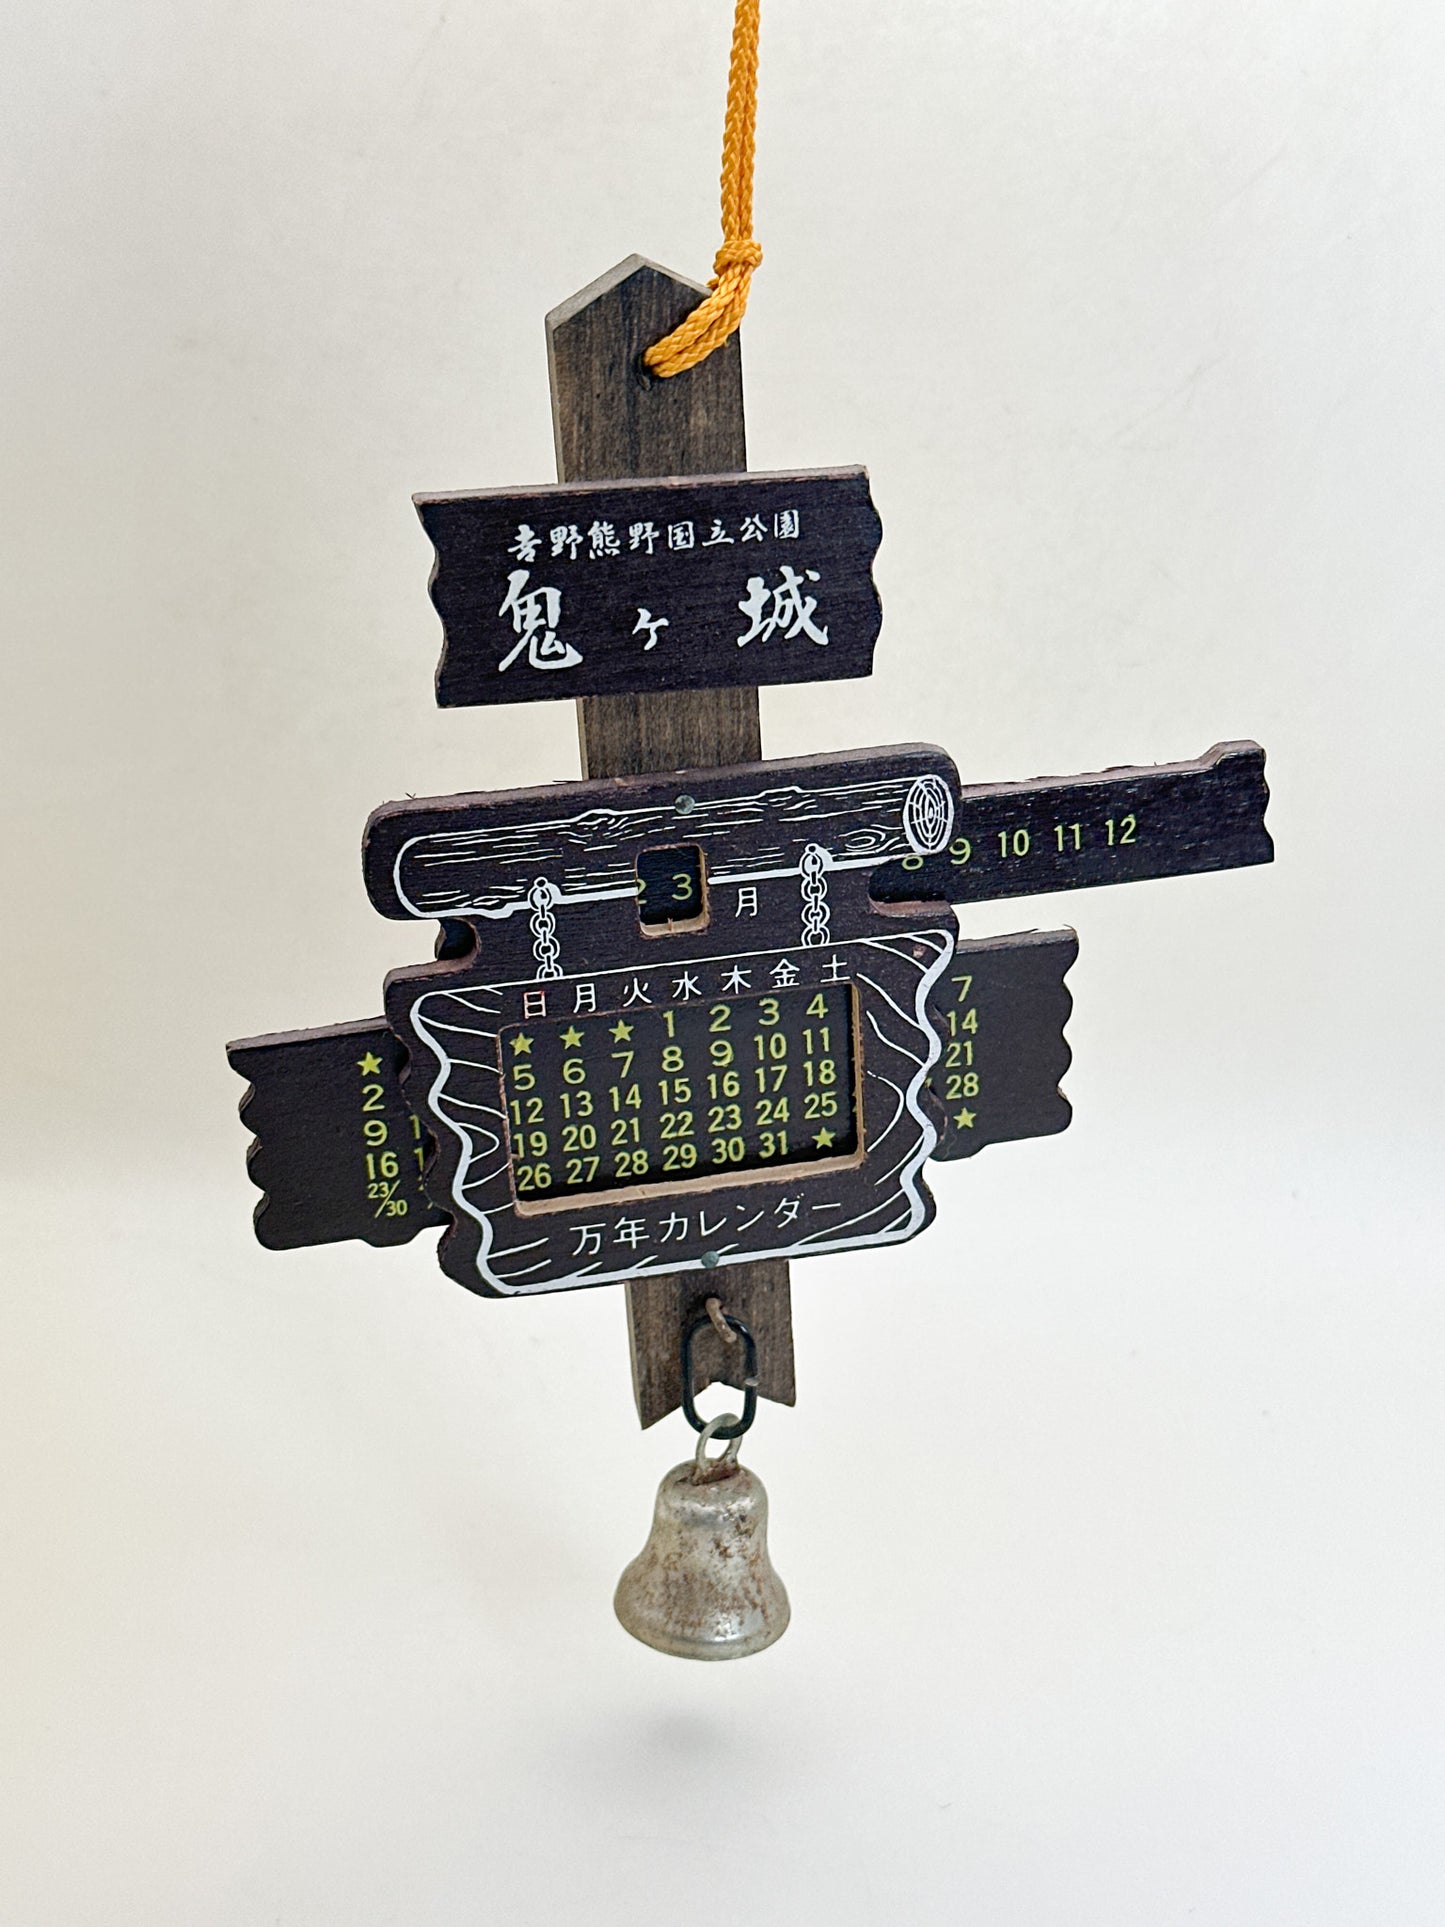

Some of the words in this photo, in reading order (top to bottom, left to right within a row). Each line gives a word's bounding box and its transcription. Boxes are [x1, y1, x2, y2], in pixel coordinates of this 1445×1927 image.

[506, 508, 801, 564] 吉野熊野国立公園
[949, 837, 972, 865] 9
[997, 829, 1030, 858] 10
[1054, 823, 1083, 852] 11
[1105, 815, 1137, 845] 12
[671, 873, 693, 900] 3
[735, 887, 758, 918] 月
[522, 990, 548, 1019] 日
[573, 983, 597, 1014] 月
[622, 978, 652, 1008] 火
[672, 971, 702, 1001] 水
[721, 965, 752, 994] 木
[769, 958, 800, 989] 金
[821, 954, 851, 983] 土
[951, 976, 974, 1002] 7
[662, 1011, 676, 1038] 1
[709, 1004, 732, 1032] 2
[758, 998, 781, 1026] 3
[806, 992, 829, 1019] 4
[947, 1009, 979, 1034] 14
[512, 1064, 536, 1090] 5
[562, 1058, 586, 1084] 6
[612, 1051, 635, 1078] 7
[662, 1046, 685, 1072] 8
[709, 1040, 734, 1067] 9
[754, 1034, 788, 1061] 10
[802, 1028, 830, 1054] 11
[946, 1042, 974, 1067] 21
[361, 1084, 385, 1112] 2
[511, 1097, 545, 1125] 12
[560, 1090, 594, 1118] 13
[609, 1084, 642, 1112] 14
[659, 1078, 692, 1106] 15
[708, 1071, 741, 1098] 16
[756, 1066, 788, 1092] 17
[803, 1060, 837, 1086] 18
[945, 1075, 980, 1098] 28
[362, 1120, 389, 1146] 9
[514, 1131, 548, 1159] 19
[562, 1124, 597, 1151] 20
[611, 1118, 640, 1145] 21
[660, 1111, 695, 1138] 22
[708, 1105, 742, 1132] 23
[756, 1098, 790, 1126] 24
[804, 1092, 838, 1119] 25
[365, 1151, 400, 1180] 16
[517, 1164, 552, 1191] 26
[566, 1157, 600, 1184] 27
[615, 1150, 649, 1177] 28
[663, 1143, 698, 1171] 29
[712, 1137, 746, 1163] 30
[759, 1131, 789, 1158] 31
[569, 1192, 842, 1256] 万年カレンダー
